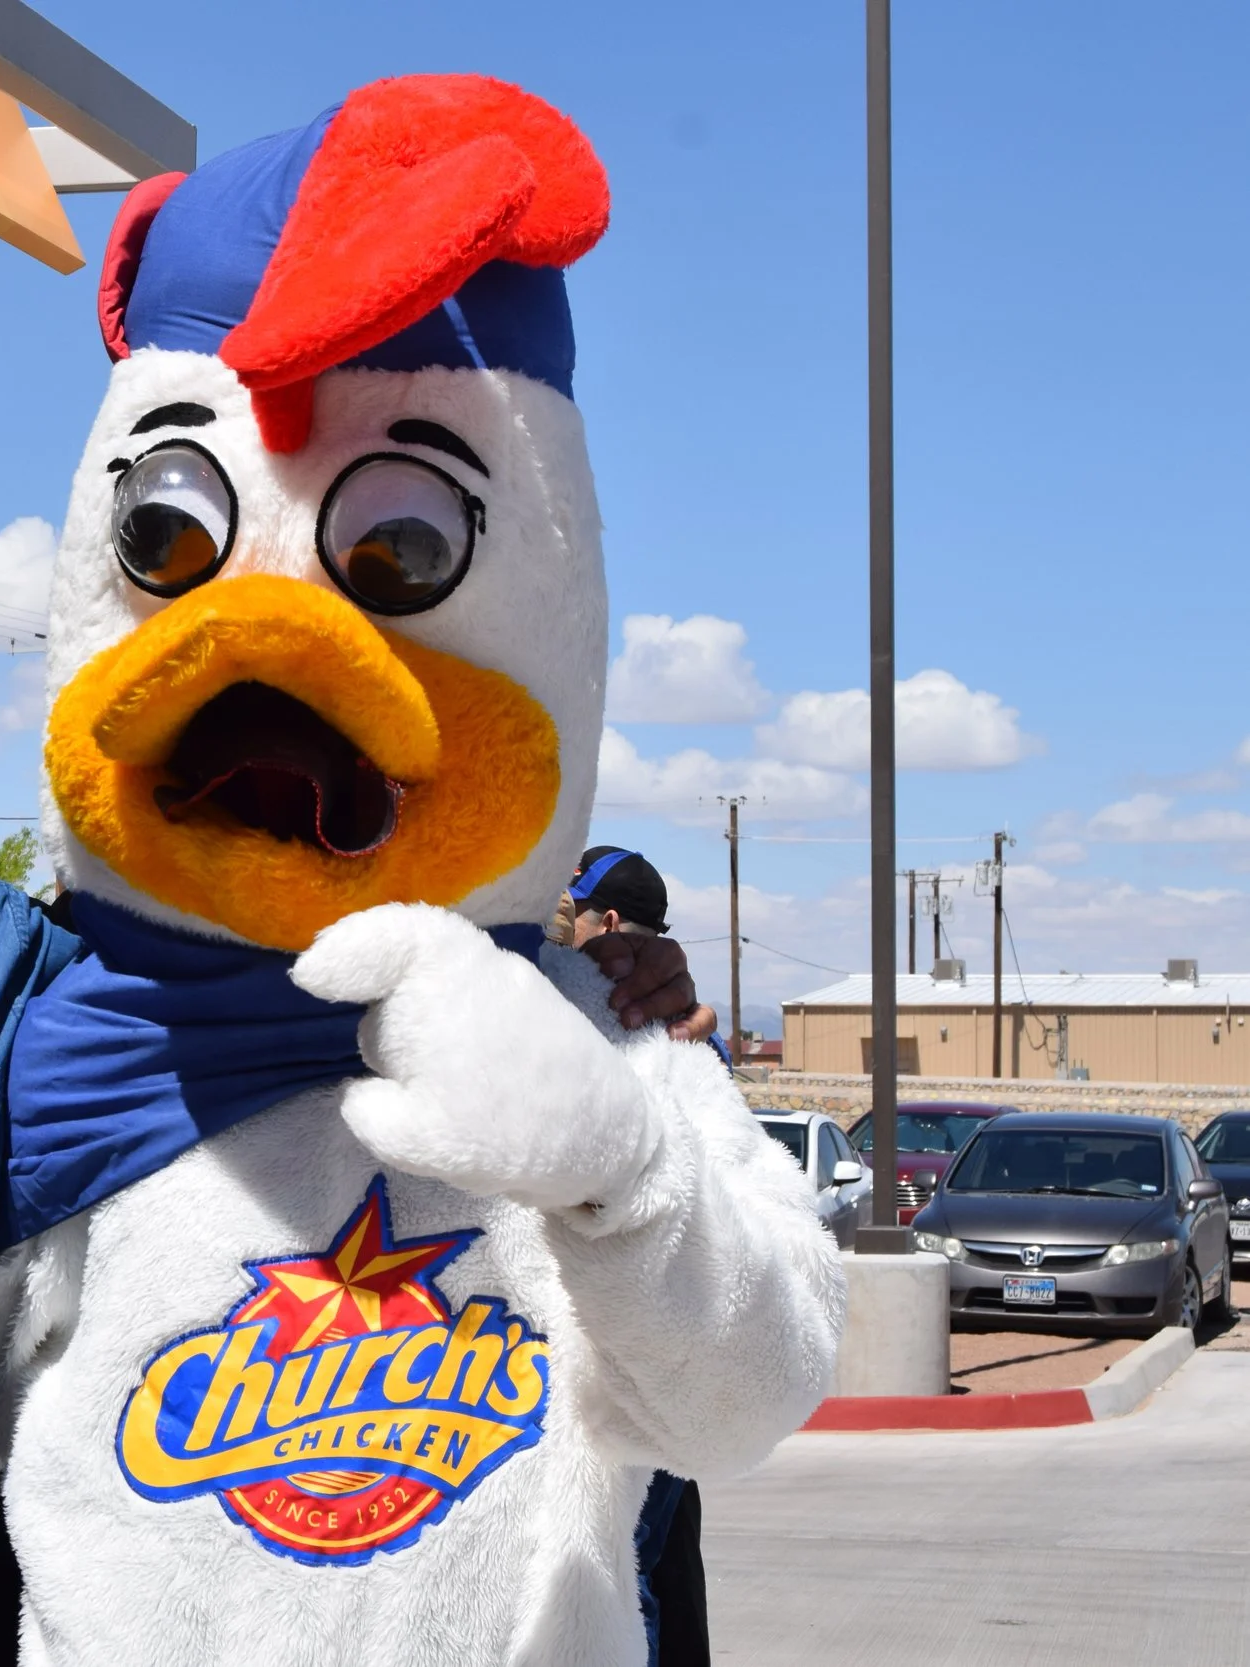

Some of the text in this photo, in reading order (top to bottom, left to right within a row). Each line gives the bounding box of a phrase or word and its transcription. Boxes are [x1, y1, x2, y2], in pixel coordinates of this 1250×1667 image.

[121, 1302, 550, 1488] Church's
[273, 1422, 471, 1470] CHICKEN
[264, 1487, 410, 1529] SINCE 1952
